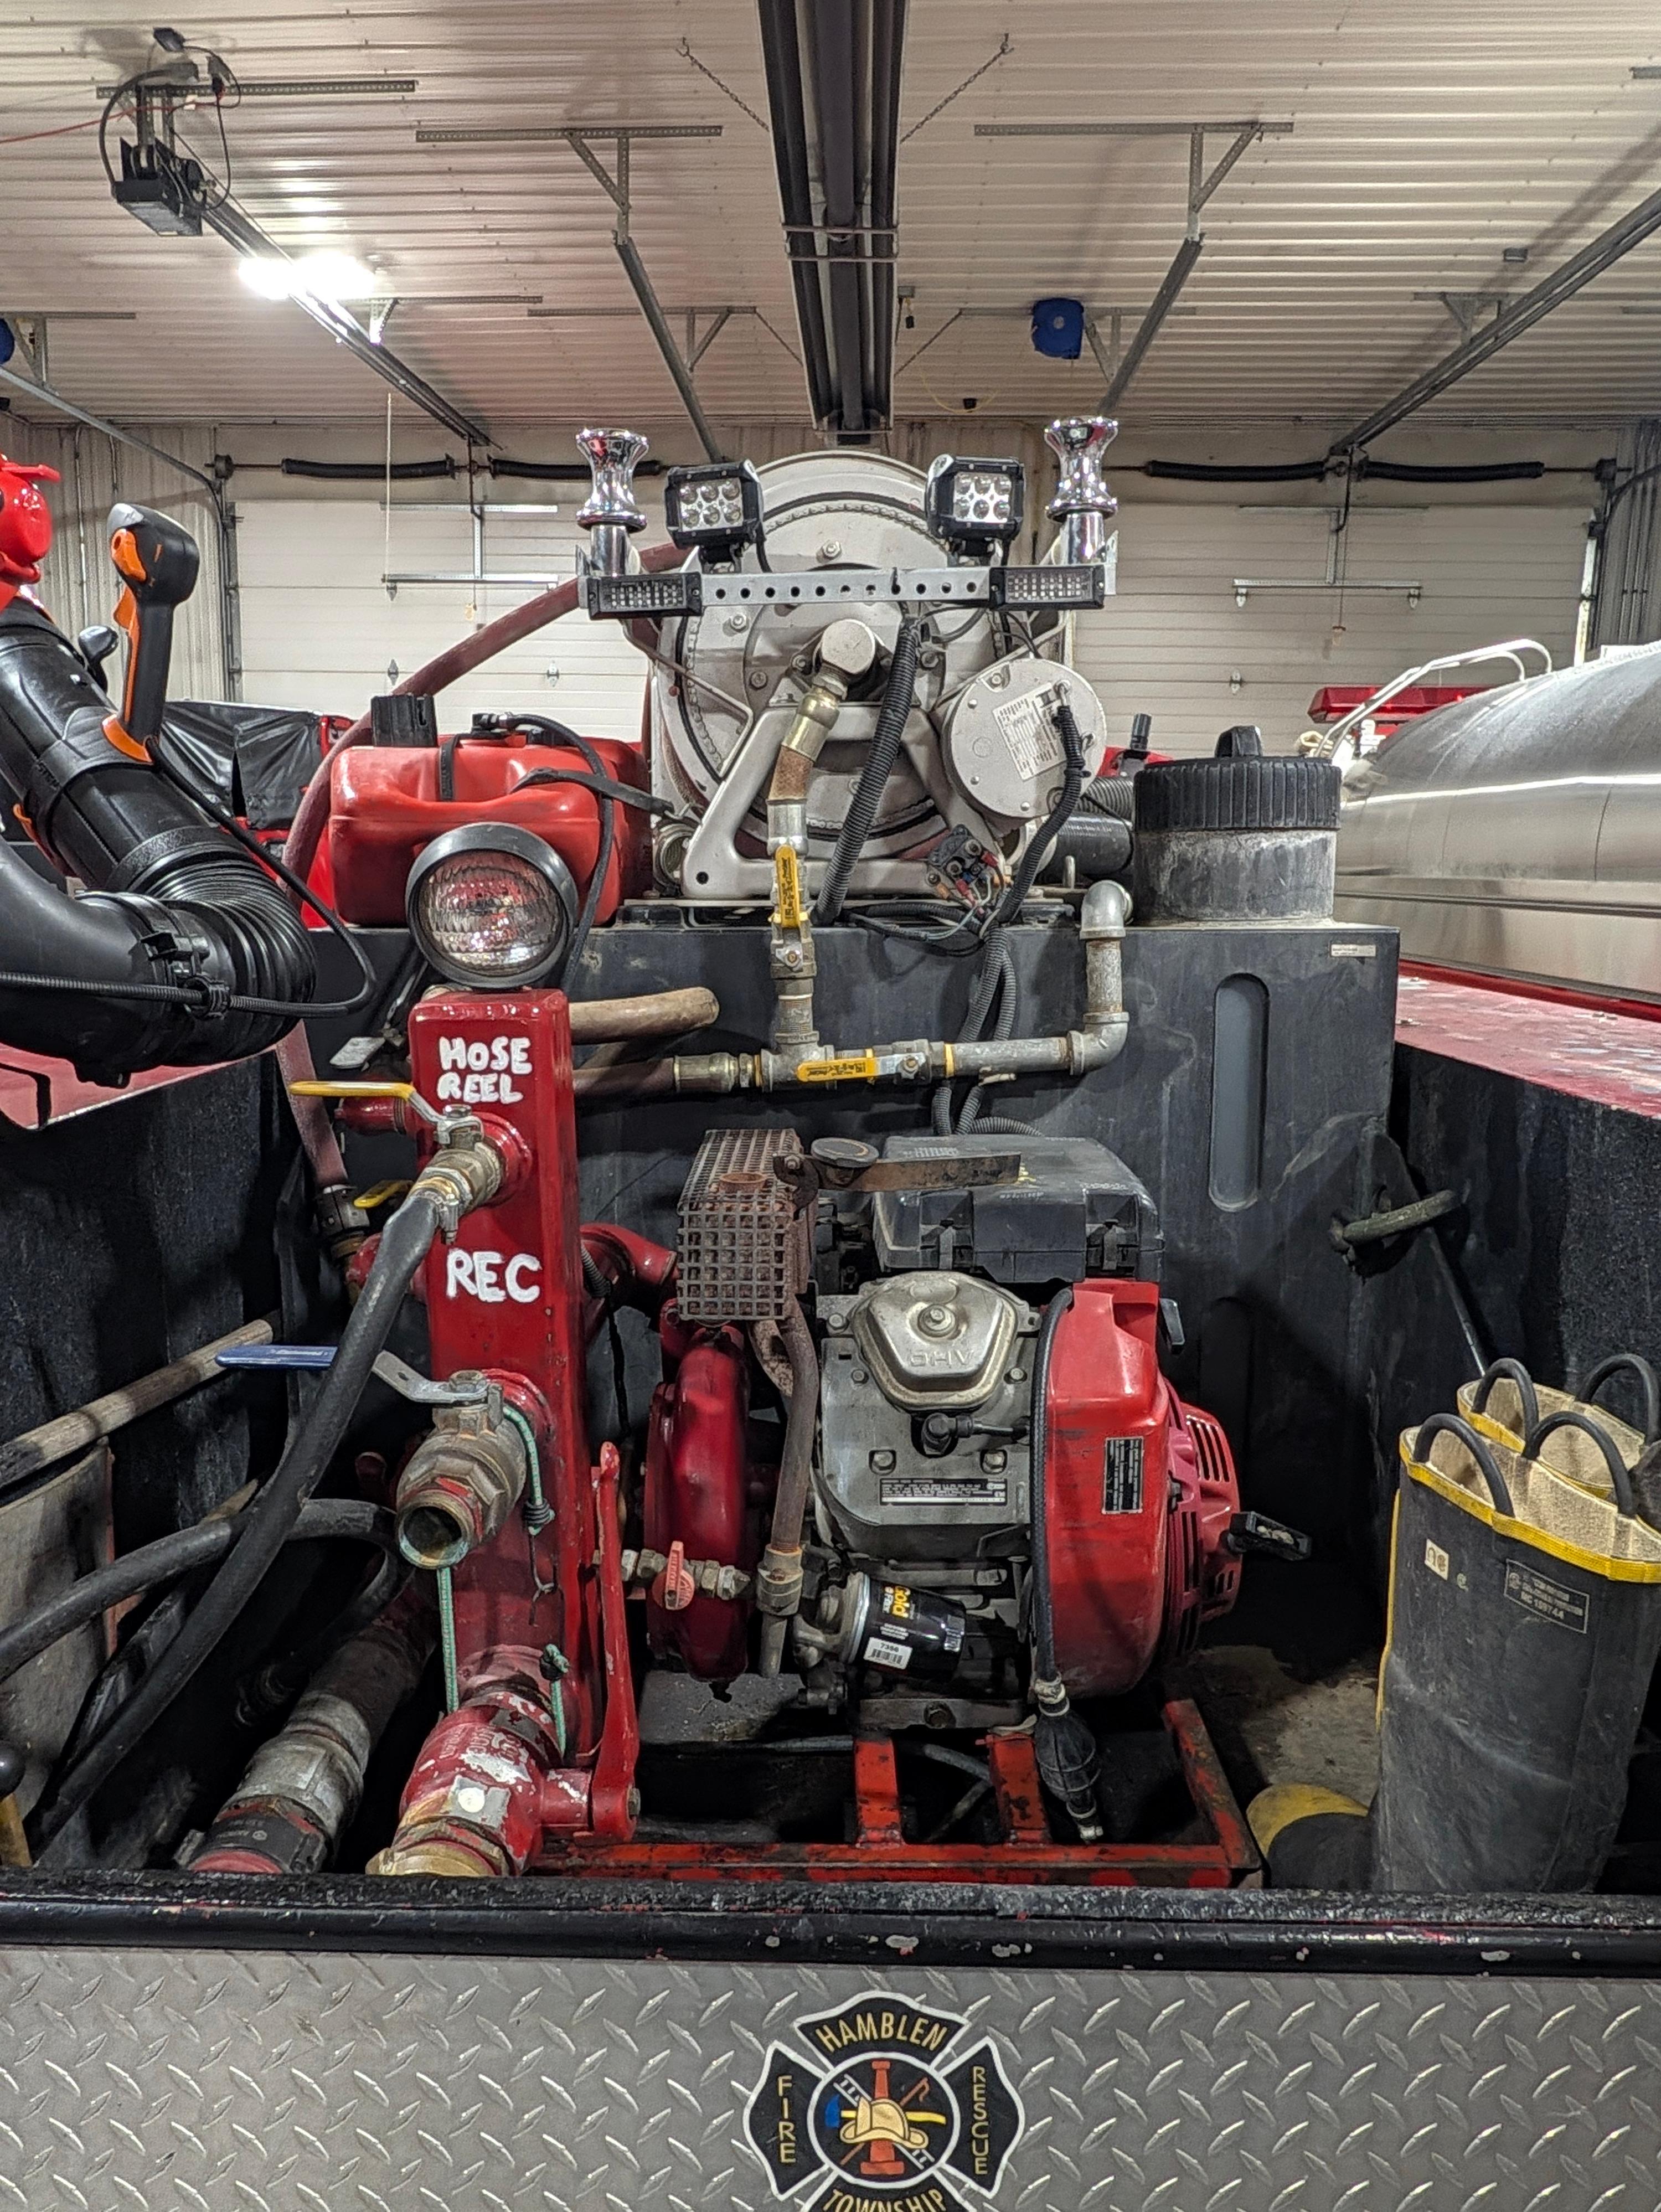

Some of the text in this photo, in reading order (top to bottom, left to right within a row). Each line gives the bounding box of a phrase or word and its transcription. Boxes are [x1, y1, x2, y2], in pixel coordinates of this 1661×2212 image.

[439, 1037, 532, 1075] HOSE
[437, 1072, 523, 1104] REEL
[445, 1247, 542, 1303] REC
[893, 1586, 911, 1618] Gold
[816, 2012, 948, 2053] HAMBLEN
[777, 2075, 797, 2164] FIRE
[971, 2066, 988, 2175] RESCUE
[823, 2189, 946, 2212] TOWNSHIP
